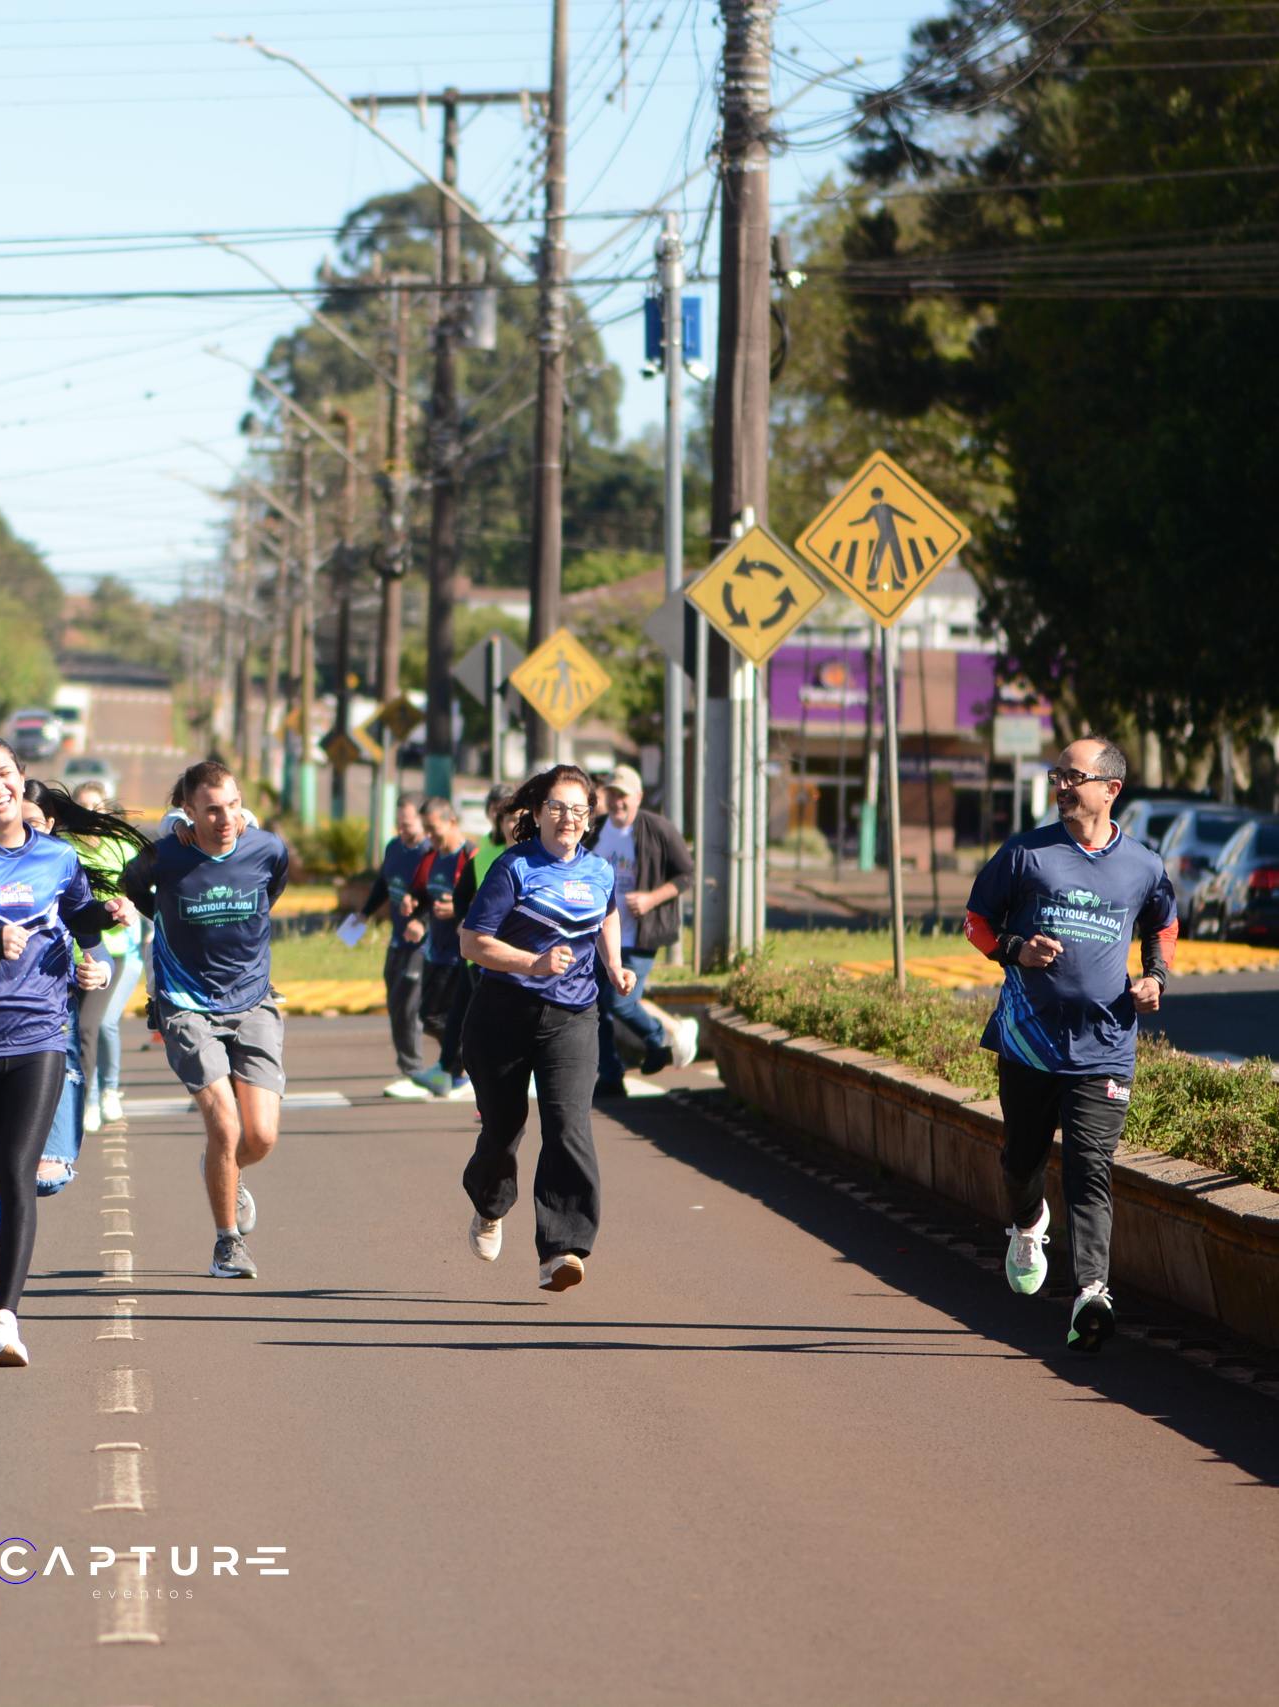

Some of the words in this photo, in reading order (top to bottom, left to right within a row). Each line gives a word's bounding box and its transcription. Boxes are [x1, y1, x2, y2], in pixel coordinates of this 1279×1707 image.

[186, 902, 226, 914] PRATIQUE
[227, 901, 252, 910] AJUDA
[1041, 907, 1089, 921] PRATIQUE
[1089, 913, 1121, 931] AJUDA
[1071, 929, 1090, 939] FÍSICA
